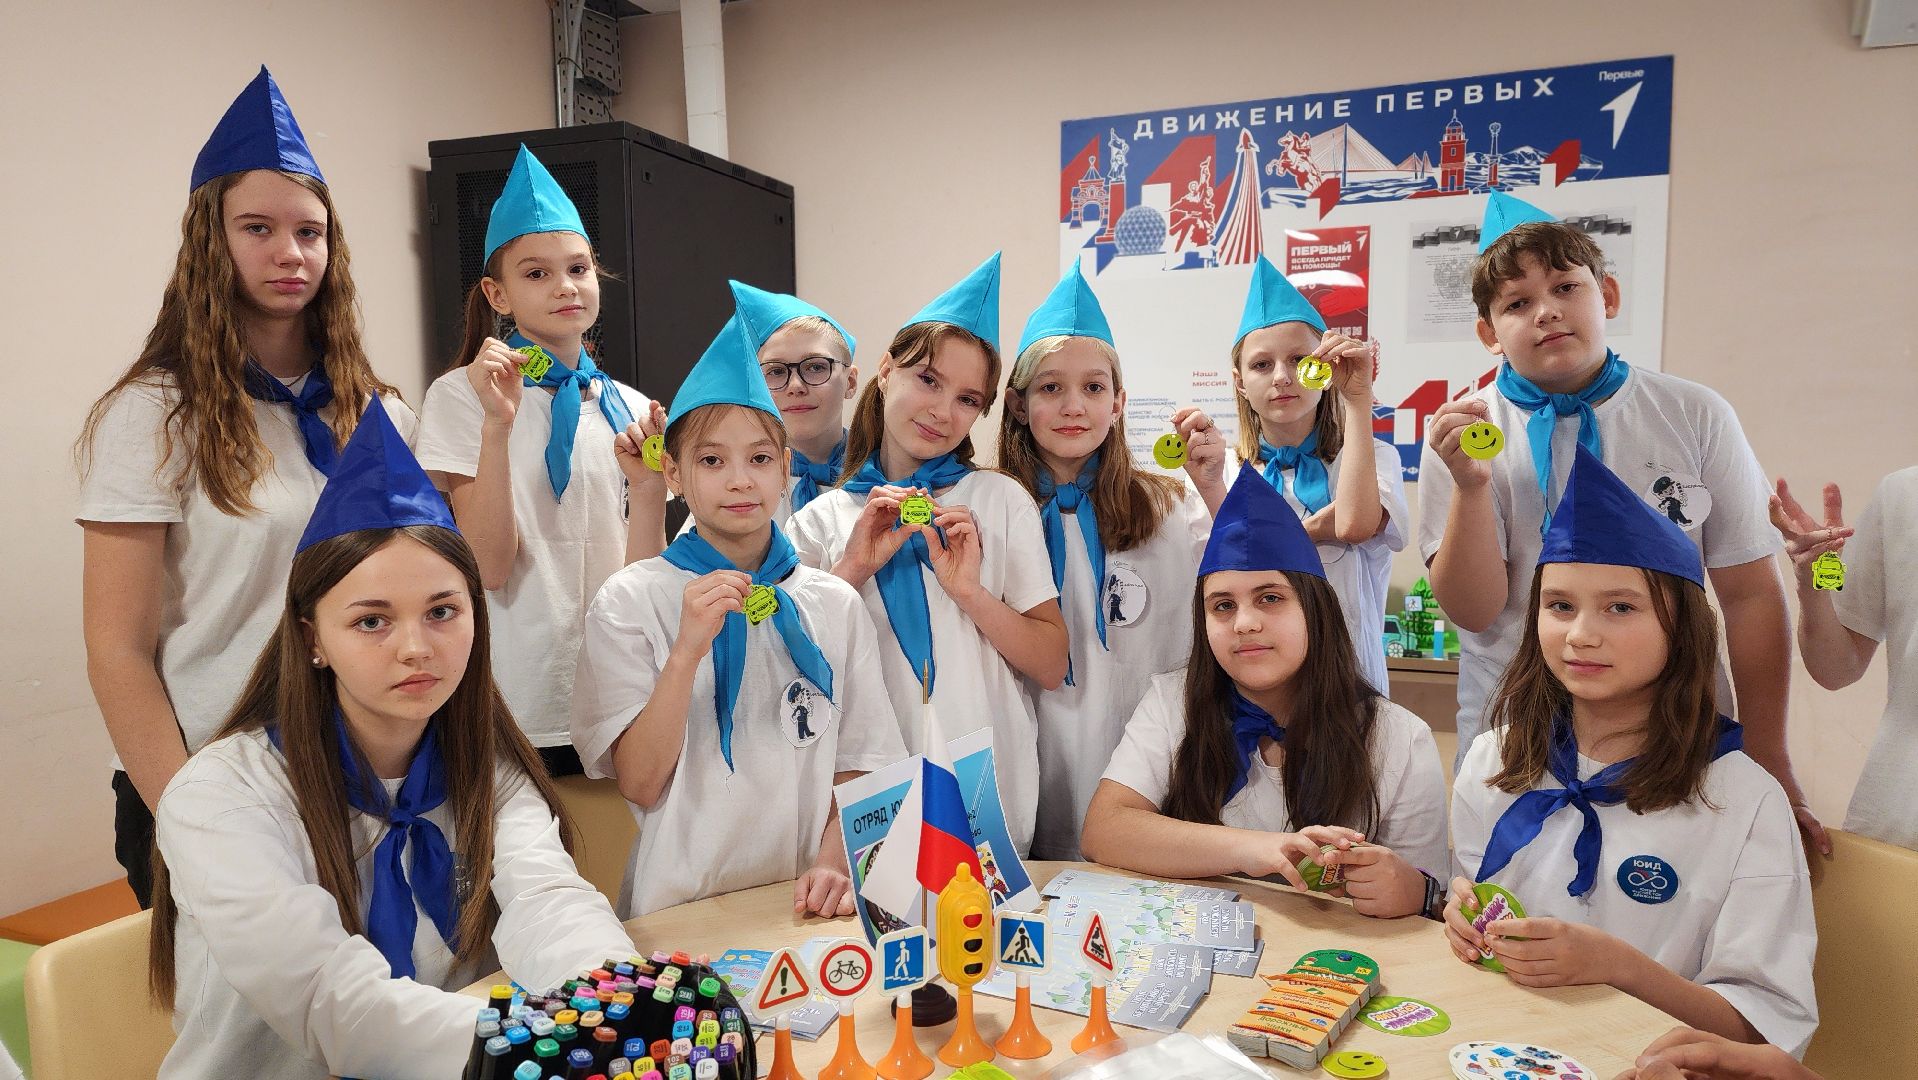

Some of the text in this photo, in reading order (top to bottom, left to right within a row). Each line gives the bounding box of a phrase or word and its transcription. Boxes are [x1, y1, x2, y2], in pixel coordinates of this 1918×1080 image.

[1598, 68, 1645, 83] Первые
[1133, 76, 1555, 141] ДВИЖЕНИЕ ПЕРВЫХ
[1291, 241, 1352, 256] ПЕРВЫЙ
[853, 806, 889, 834] ОТРЯД
[1633, 859, 1662, 871] ЮИД
